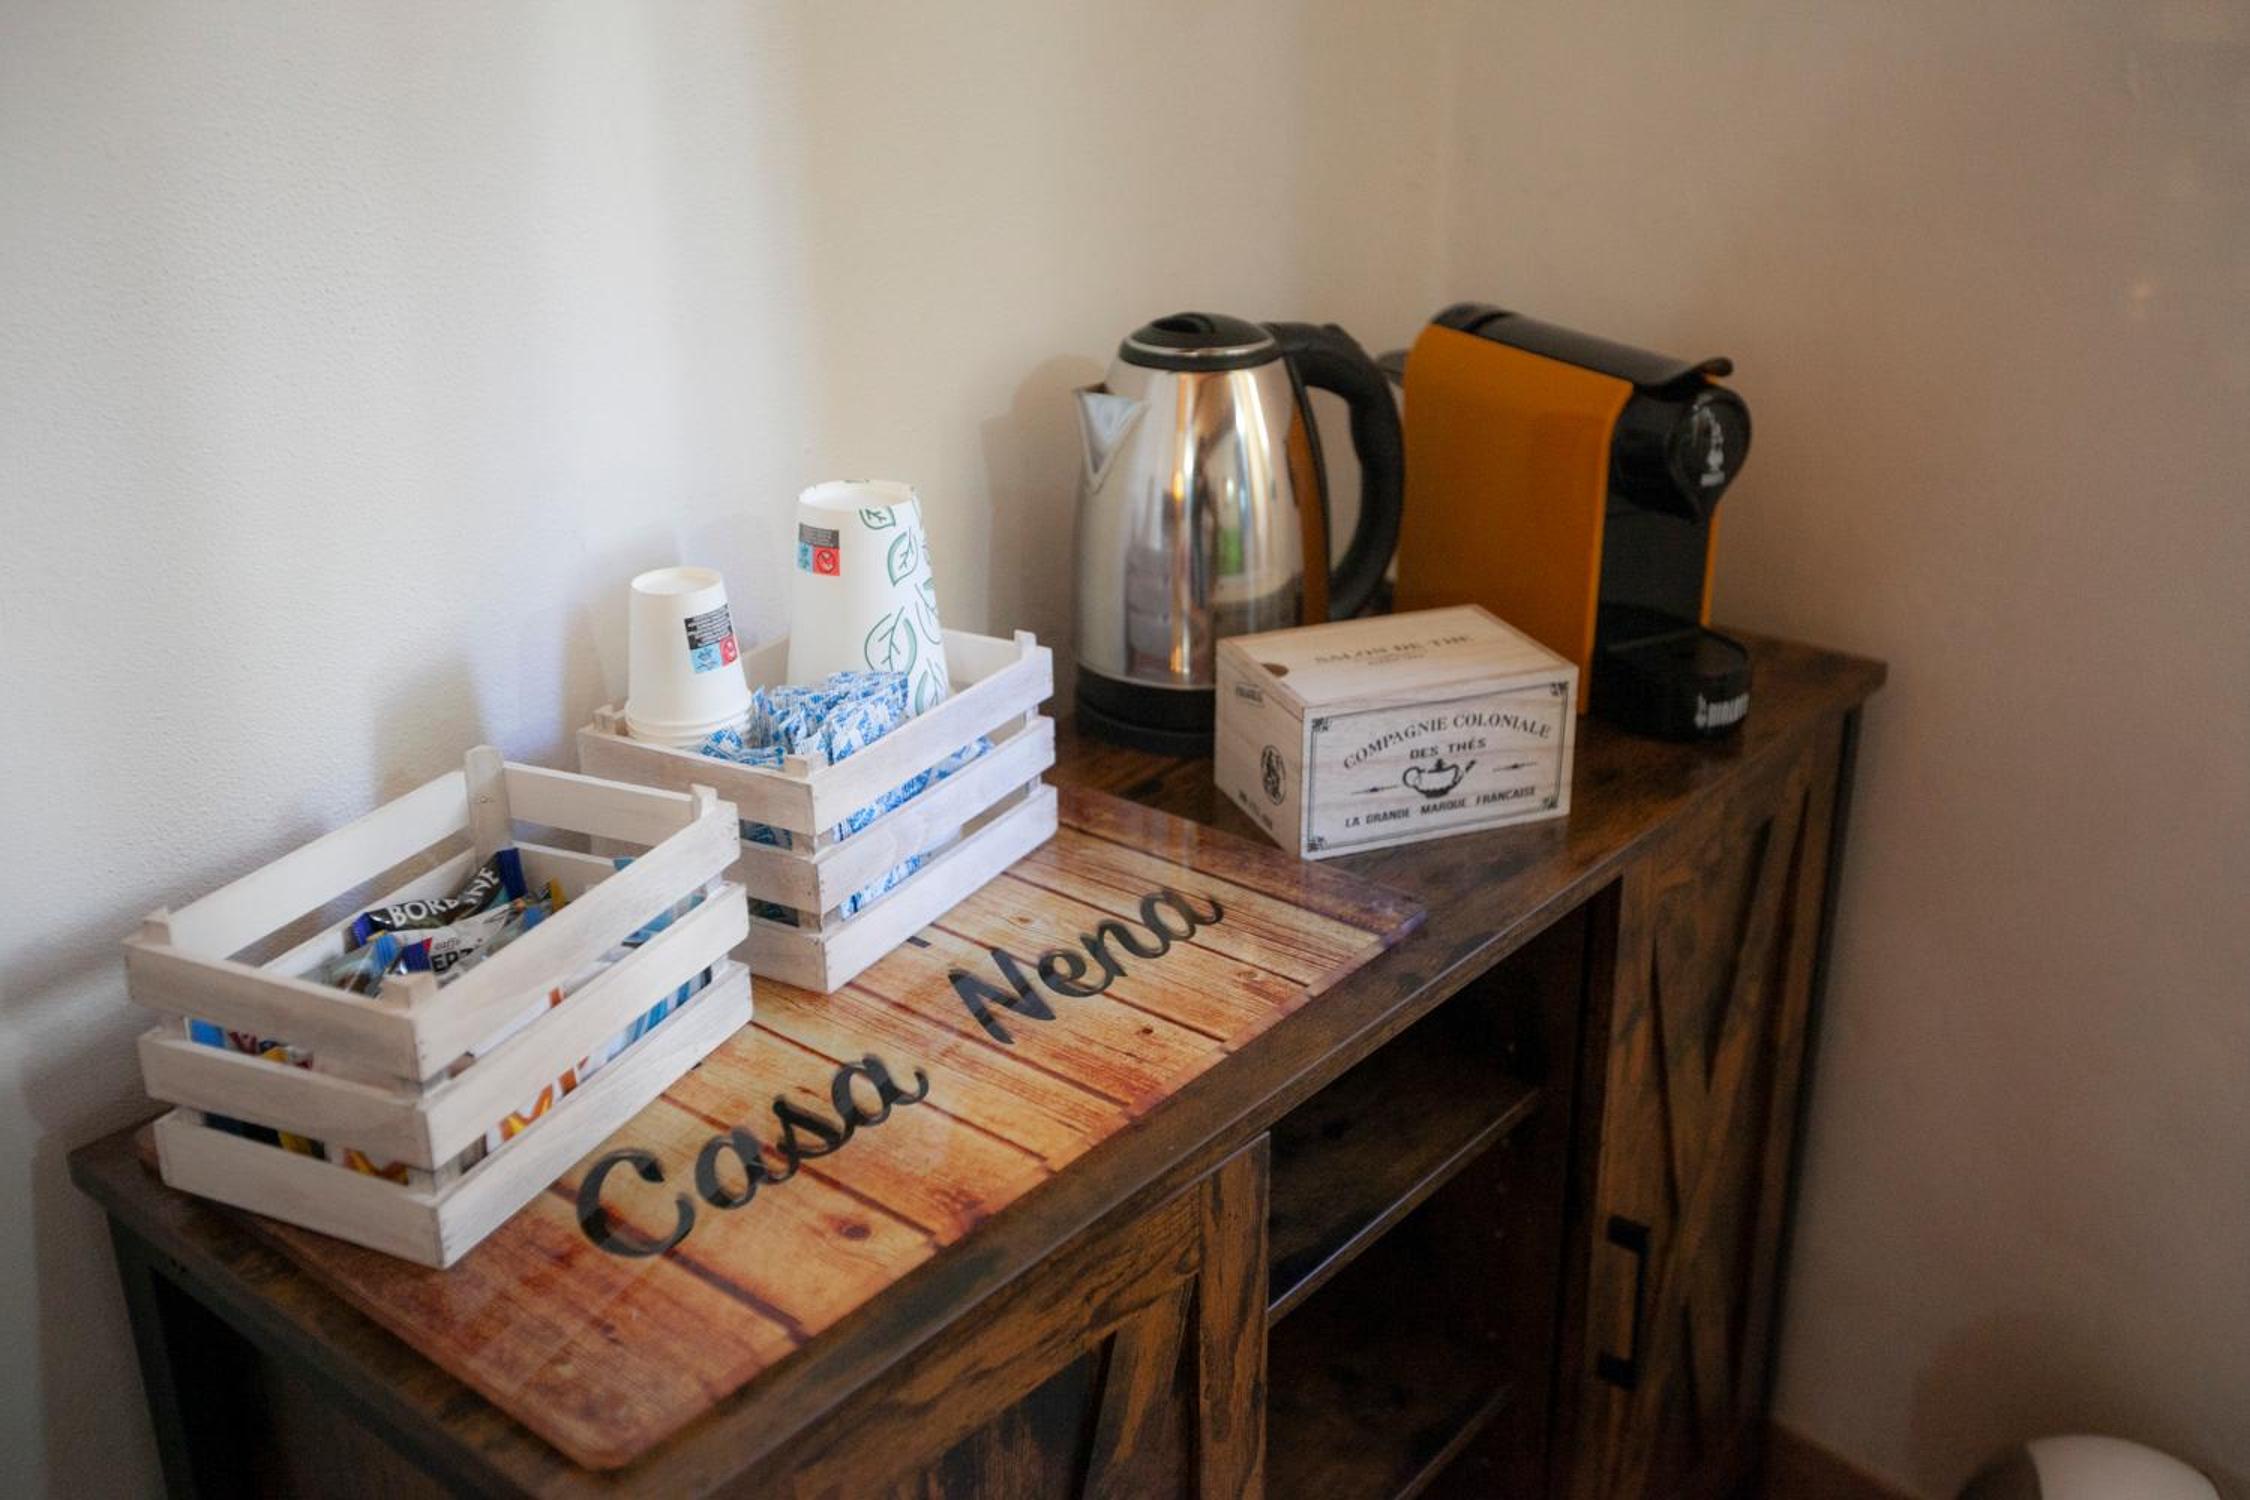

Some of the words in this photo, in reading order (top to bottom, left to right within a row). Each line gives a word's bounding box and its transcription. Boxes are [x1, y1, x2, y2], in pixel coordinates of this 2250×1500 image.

[1344, 716, 1448, 769] COMPAGNIE
[1453, 713, 1550, 739] COLONIALE
[1410, 745, 1439, 760] DES
[1449, 737, 1487, 755] THÉS
[1345, 816, 1361, 828] LA
[1366, 808, 1411, 825] GRANDE
[1420, 798, 1466, 816] MARQUE
[576, 1053, 929, 1258] Casa
[947, 886, 1224, 1045] Nena
